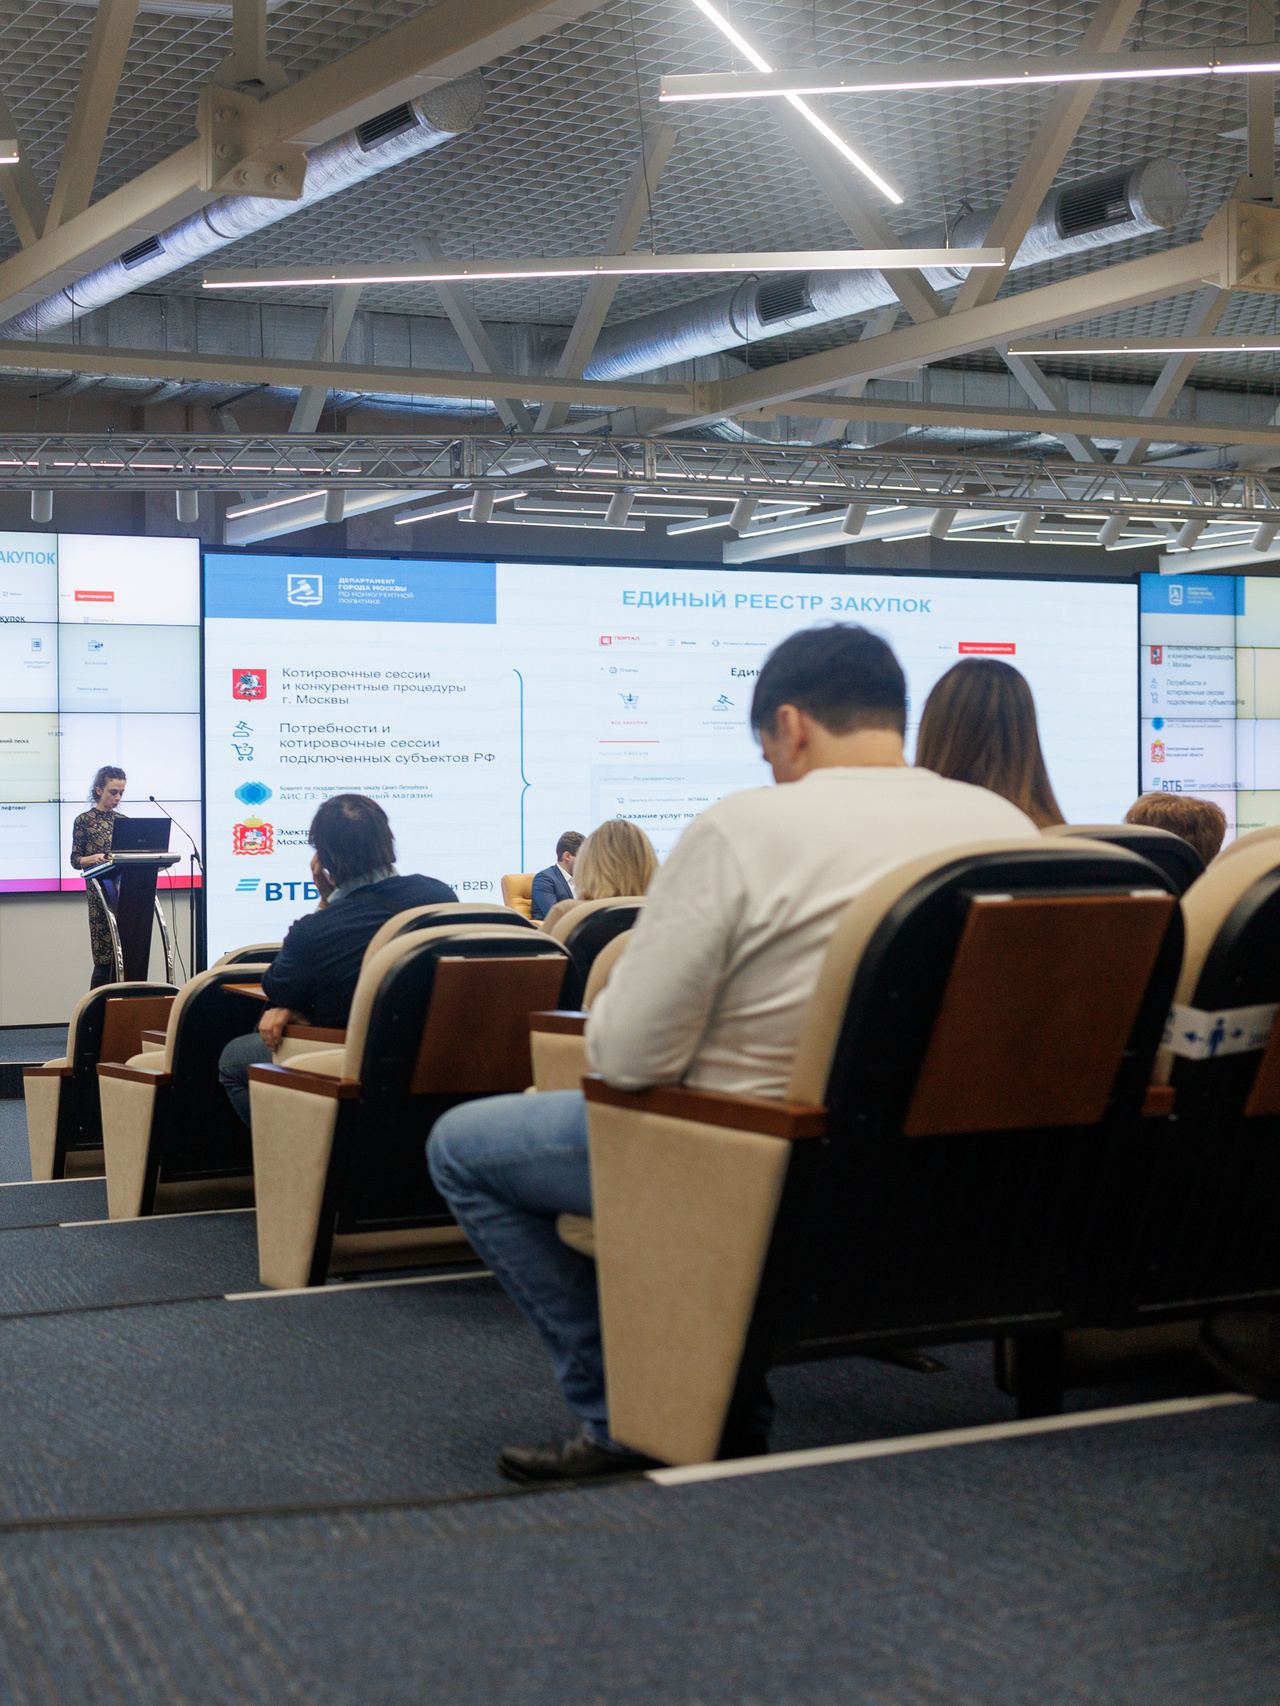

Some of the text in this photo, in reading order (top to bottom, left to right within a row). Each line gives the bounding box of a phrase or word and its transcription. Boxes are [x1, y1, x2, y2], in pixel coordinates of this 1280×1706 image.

[338, 577, 395, 585] ДЕПАРТАМЕНТ
[351, 591, 414, 599] КОНКУРЕНТНОЙ
[622, 590, 932, 613] ЕДИНЫЙ РЕЕСТР ЗАКУПОК
[282, 668, 431, 679] Котировочные сессии
[295, 682, 389, 693] конкурентные
[393, 684, 466, 694] процедуры
[282, 695, 349, 705] г. Москвы
[280, 723, 390, 735] Потребности и
[280, 739, 440, 750] котировочные сессии
[280, 753, 496, 765] подключенных субъектов РФ
[1162, 780, 1182, 792] ВТБ
[280, 792, 302, 800] АИС
[304, 792, 319, 800] ГЗ:
[265, 881, 320, 901] ВТБ
